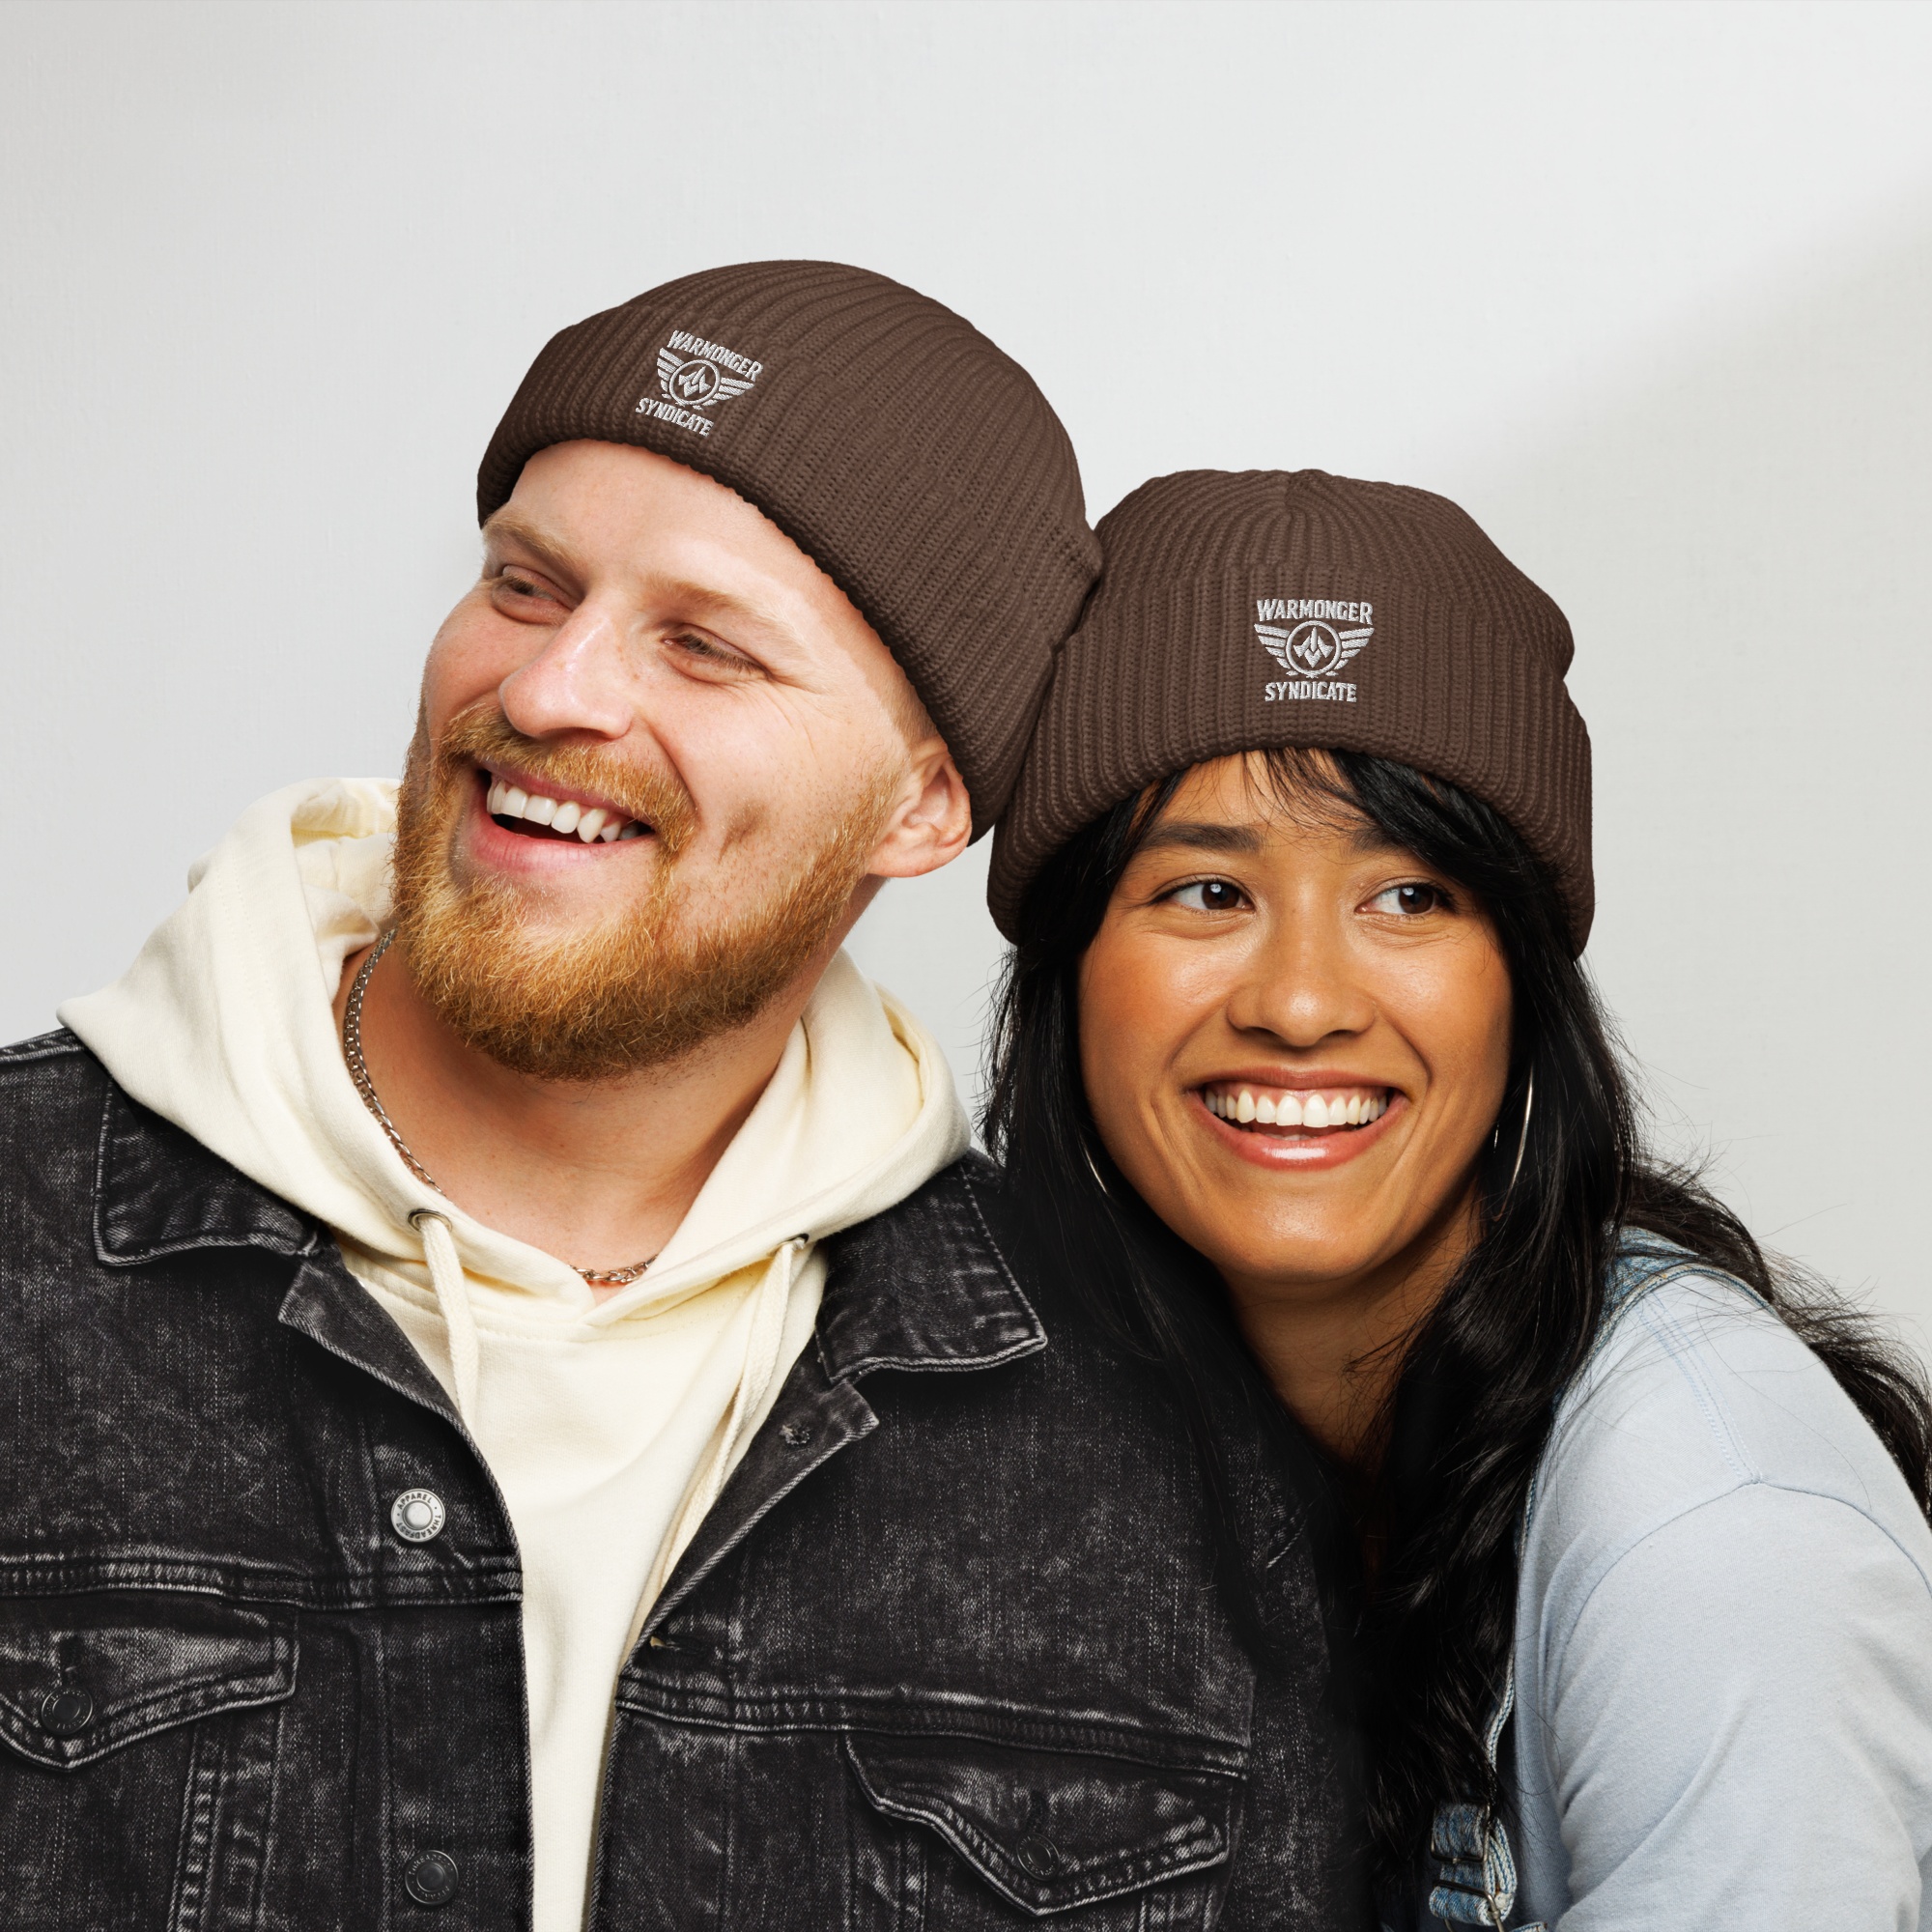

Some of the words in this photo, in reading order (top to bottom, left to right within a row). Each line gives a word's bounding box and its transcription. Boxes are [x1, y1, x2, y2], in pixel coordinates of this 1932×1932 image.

[667, 329, 763, 383] WARMONGER
[635, 397, 714, 438] SYNDICATE
[1257, 598, 1374, 625] WARMONGER
[1264, 680, 1357, 702] SYNDICATE
[397, 1492, 432, 1510] APPAREL
